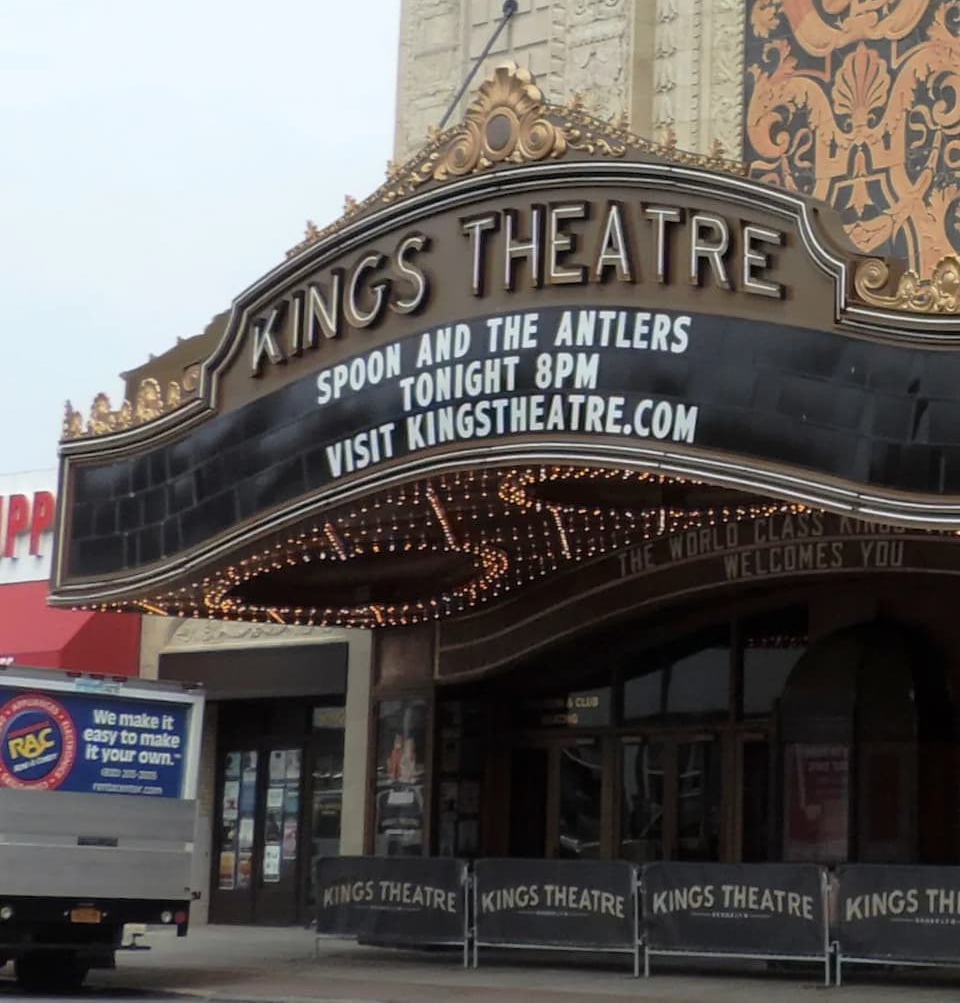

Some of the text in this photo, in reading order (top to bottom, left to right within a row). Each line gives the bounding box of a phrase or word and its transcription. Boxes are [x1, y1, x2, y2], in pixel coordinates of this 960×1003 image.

[249, 199, 787, 378] KINGS THEATRE
[316, 309, 692, 405] SPOON AND THE ANTLERS
[399, 353, 600, 412] TONIGHT 8PM
[326, 394, 699, 478] VISIT KINGSTHEATRE.COM
[0, 490, 56, 558] PP
[618, 543, 655, 577] THE
[669, 521, 739, 561] WORLD
[753, 510, 825, 545] CLASS
[723, 540, 905, 580] WELCOMES YOU
[575, 695, 600, 708] CLUB
[93, 709, 175, 731] We make it
[8, 727, 56, 760] RAC
[83, 728, 181, 749] easy to make
[85, 743, 100, 760] it
[101, 748, 137, 764] your
[324, 881, 457, 913] KINGS THEATRE
[482, 884, 626, 919] KINGS THEATRE
[652, 884, 814, 921] KINGS THEATRE
[844, 889, 919, 923] KINGS
